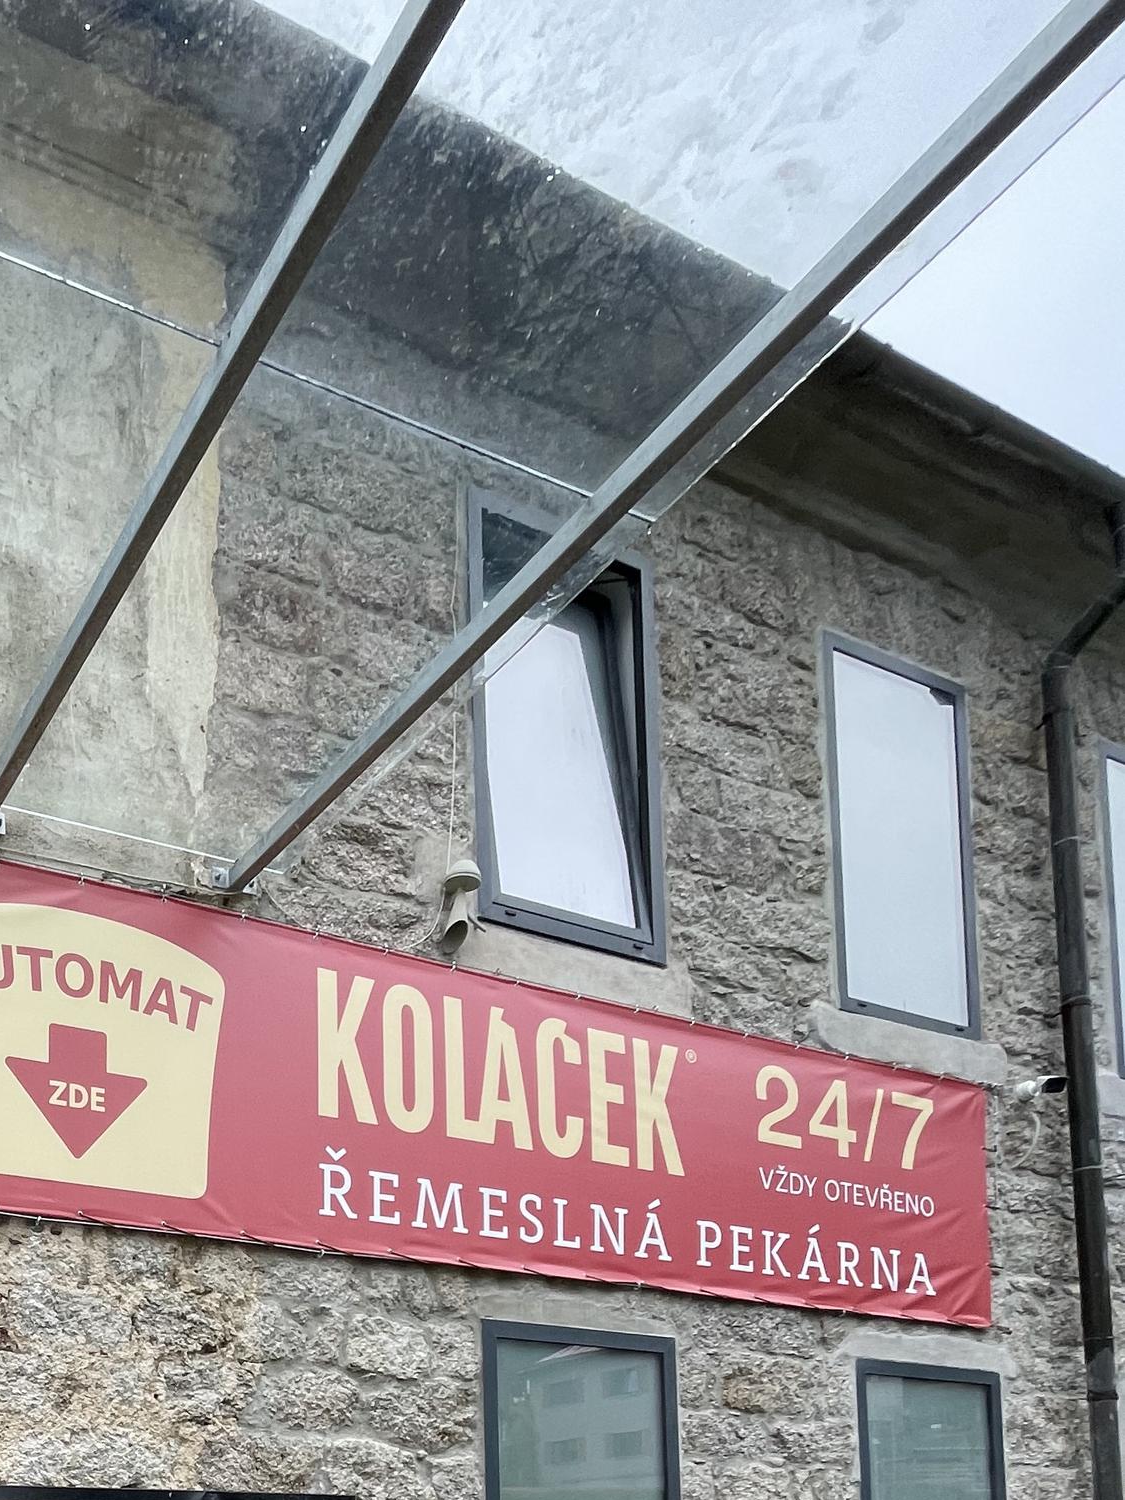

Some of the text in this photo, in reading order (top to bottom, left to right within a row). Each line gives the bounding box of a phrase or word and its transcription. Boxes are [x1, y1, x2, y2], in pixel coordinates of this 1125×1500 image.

[48, 1079, 106, 1113] ZDE
[755, 1064, 934, 1170] 24/7
[318, 1145, 937, 1296] ŘEMESLNÁ PEKÁRNA
[758, 1164, 935, 1217] VŽDY OTEVŘENO
